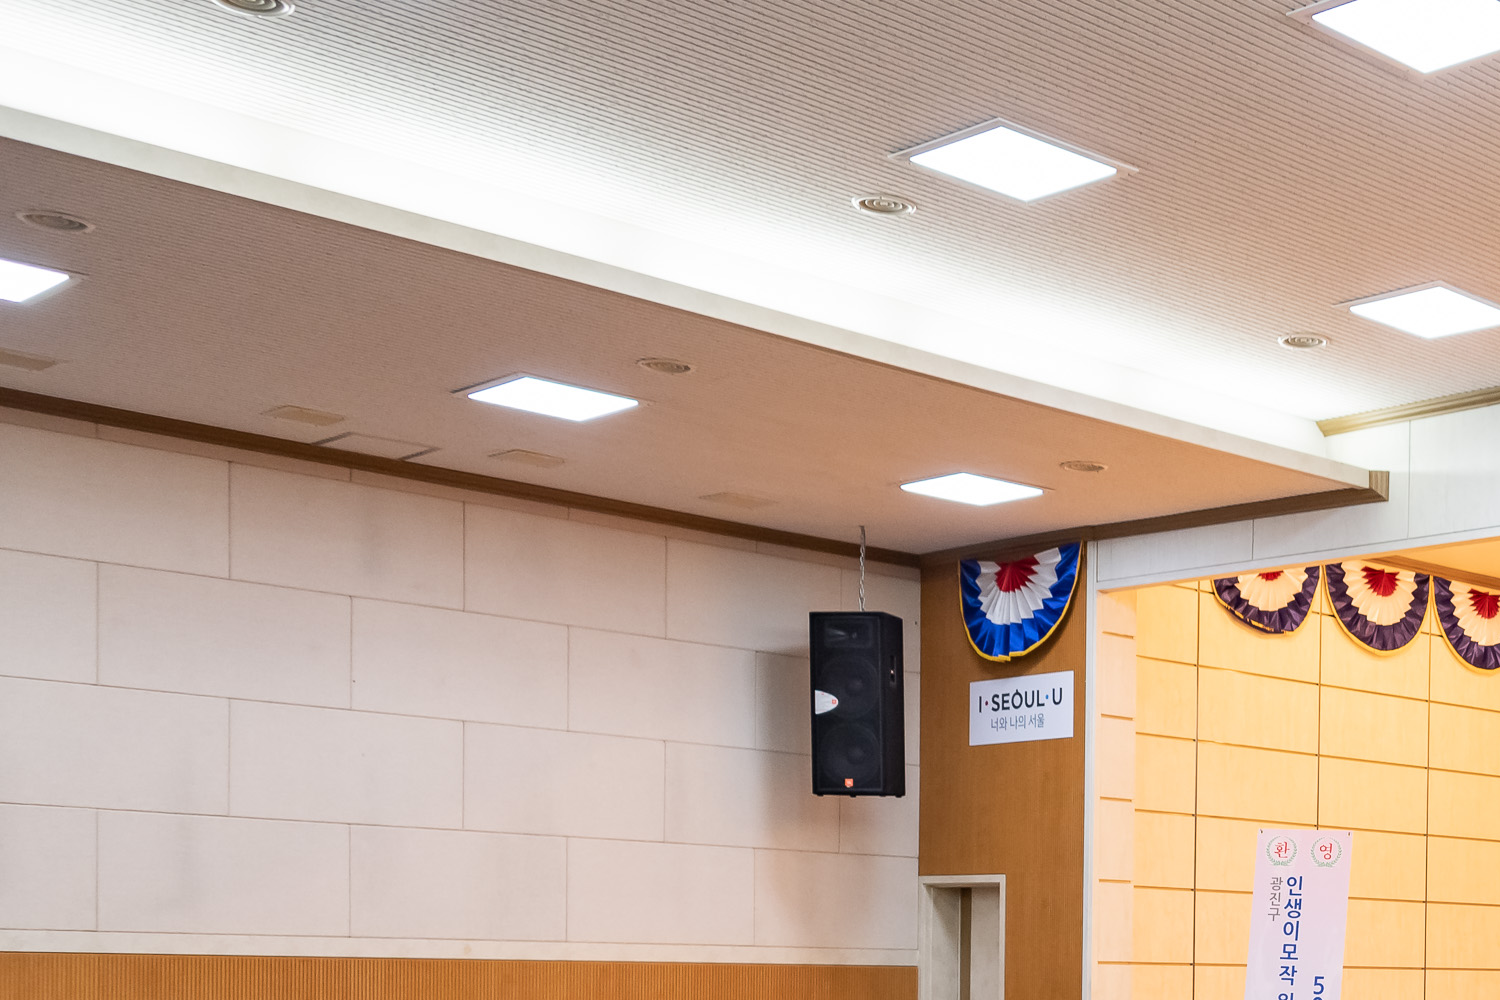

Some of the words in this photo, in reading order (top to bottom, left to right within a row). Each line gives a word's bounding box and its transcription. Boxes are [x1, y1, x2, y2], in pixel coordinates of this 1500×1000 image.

[990, 716, 1008, 732] 너와
[1009, 714, 1027, 730] 나의
[1028, 713, 1045, 729] 서울
[1267, 876, 1283, 921] 광진구
[1279, 875, 1303, 986] 인생이모작
